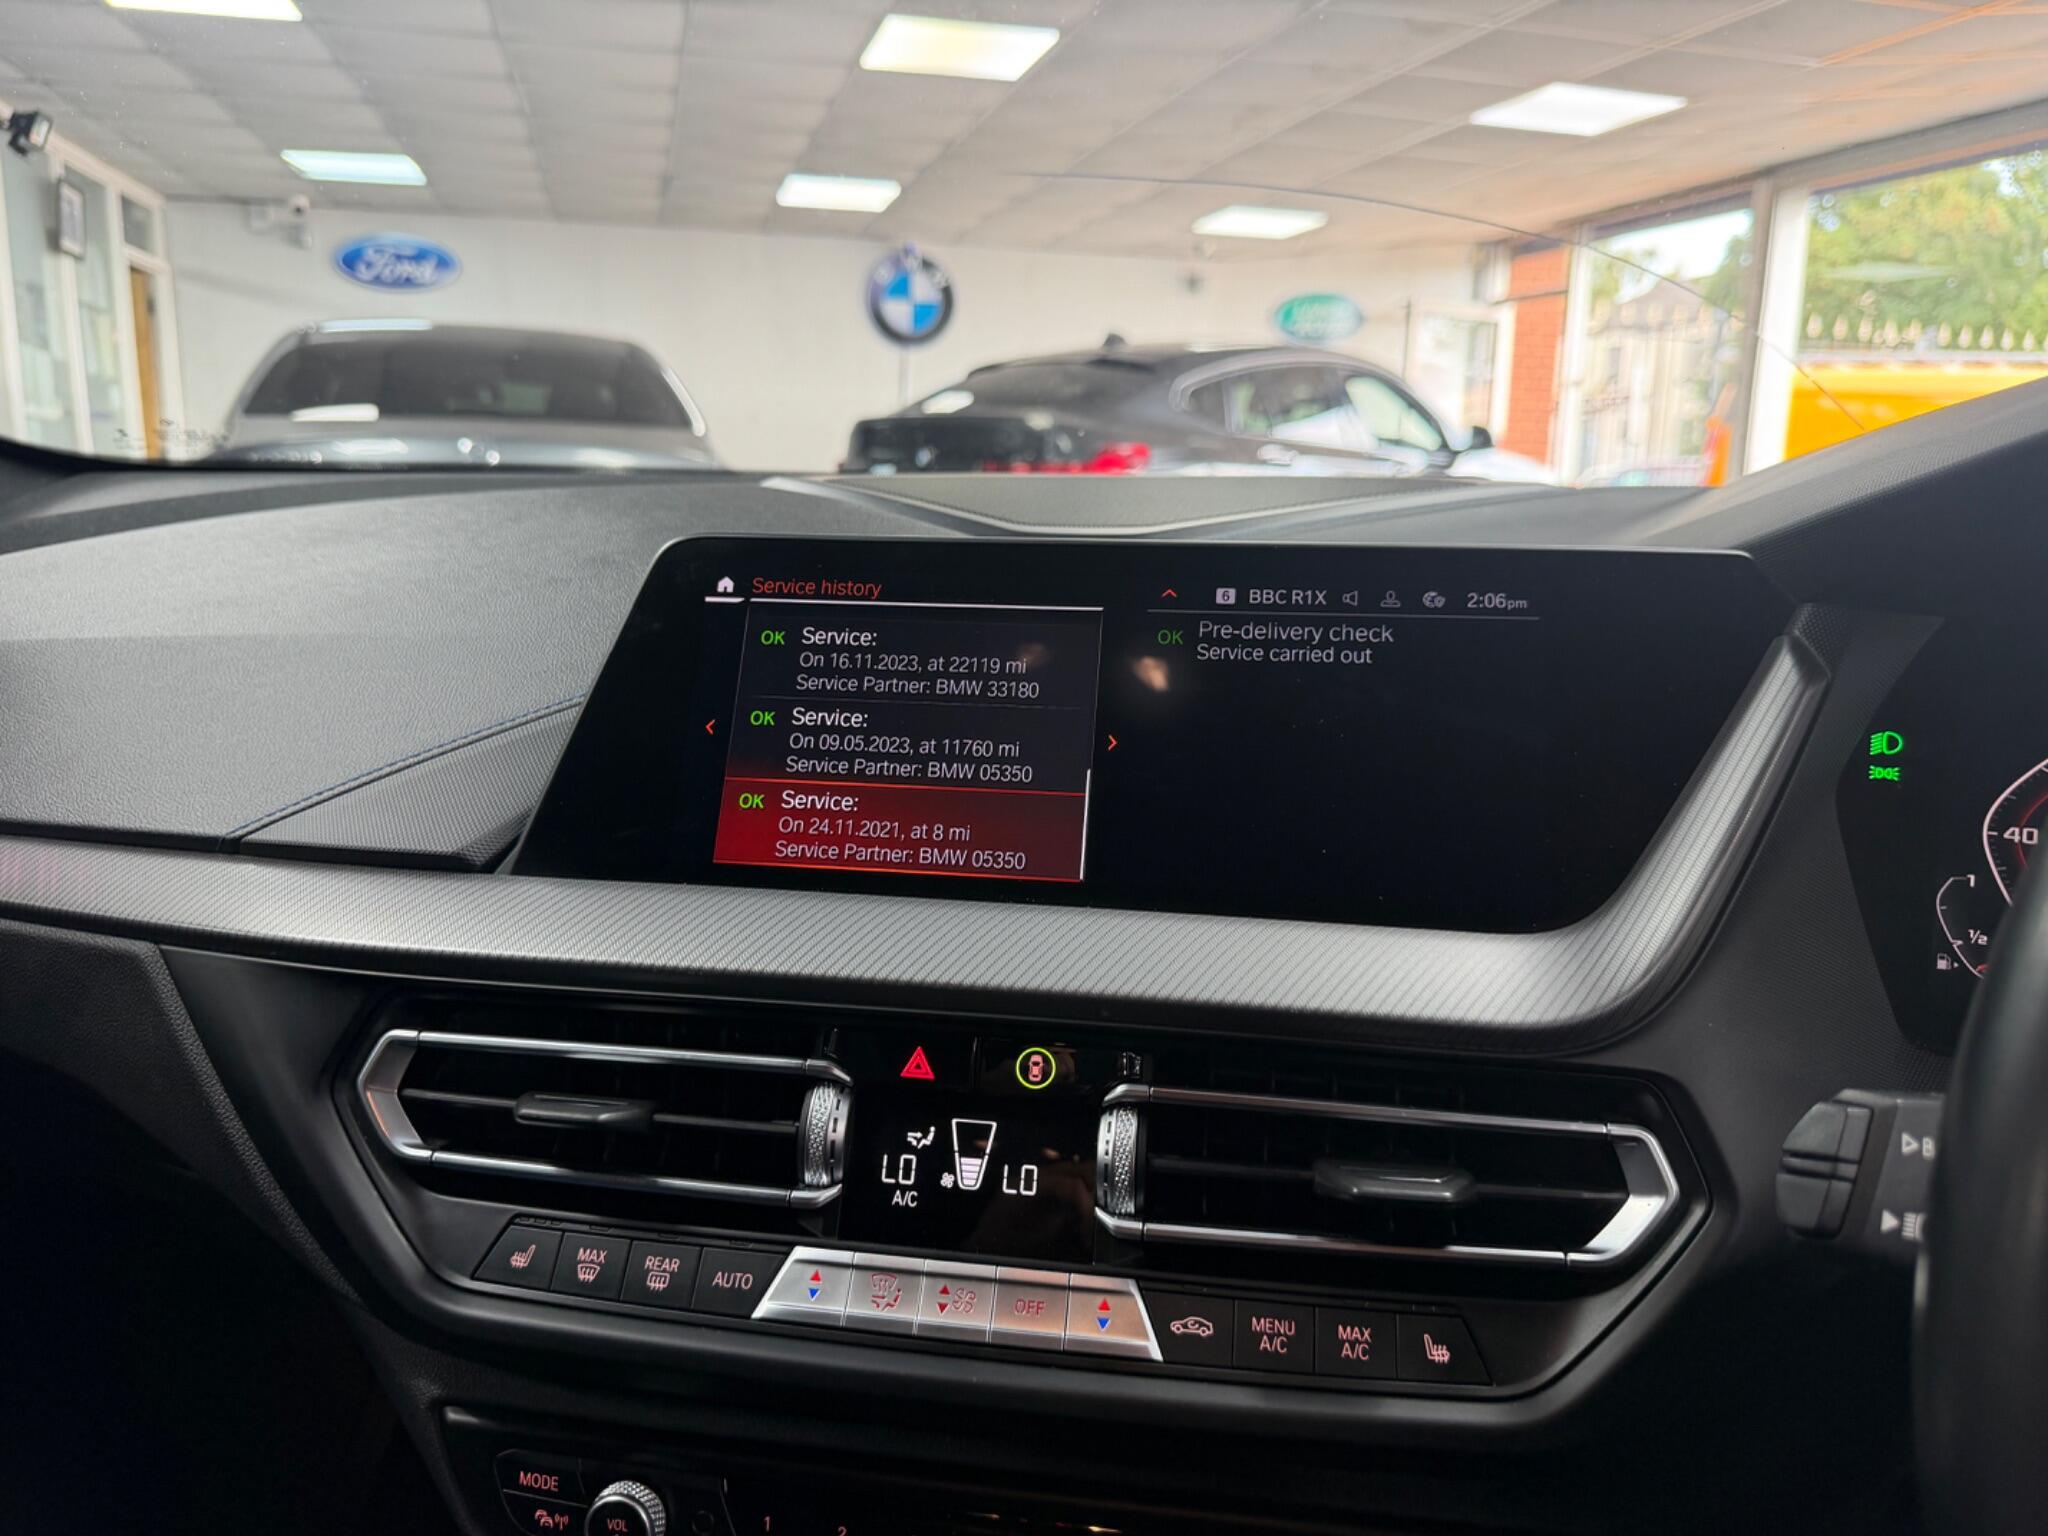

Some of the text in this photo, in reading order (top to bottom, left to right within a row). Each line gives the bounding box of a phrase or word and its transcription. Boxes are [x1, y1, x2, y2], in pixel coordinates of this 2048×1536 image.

[356, 244, 438, 284] Ford
[752, 578, 882, 600] Service history
[1249, 589, 1287, 604] BBC
[1291, 590, 1327, 605] R1X
[760, 630, 786, 645] OK
[802, 627, 878, 647] Service:
[1157, 630, 1184, 645] OK
[1199, 621, 1394, 645] Pre-delivery check
[799, 652, 1027, 674] On 16.11.2023, at 22119 mi
[1196, 645, 1373, 664] Service carried out
[796, 674, 1040, 698] Service Partner: BMW 33180
[749, 711, 775, 726] OK
[792, 707, 869, 727] Service:
[789, 733, 1020, 757] On 09.05.2023, at 11760 mi
[786, 756, 1033, 782] Service Partner: BMW 05350
[738, 793, 765, 809] OK
[781, 790, 859, 811] Service:
[778, 817, 971, 841] On 24.11.2021, at 8 mi
[2003, 827, 2039, 844] 40
[775, 841, 1026, 869] Service Partner: BMW 05350
[1966, 874, 1975, 887] 1
[892, 1190, 918, 1208] A/C
[577, 1247, 608, 1264] MAX
[645, 1256, 680, 1273] REAR
[712, 1272, 753, 1289] AUTO
[1015, 1299, 1044, 1315] OFF
[1252, 1316, 1295, 1336] MENU
[1337, 1325, 1372, 1342] MAX
[1259, 1335, 1288, 1353] A/C
[1341, 1342, 1369, 1360] A/C
[519, 1470, 559, 1492] MODE
[607, 1519, 627, 1532] VOL
[764, 1516, 770, 1532] 1
